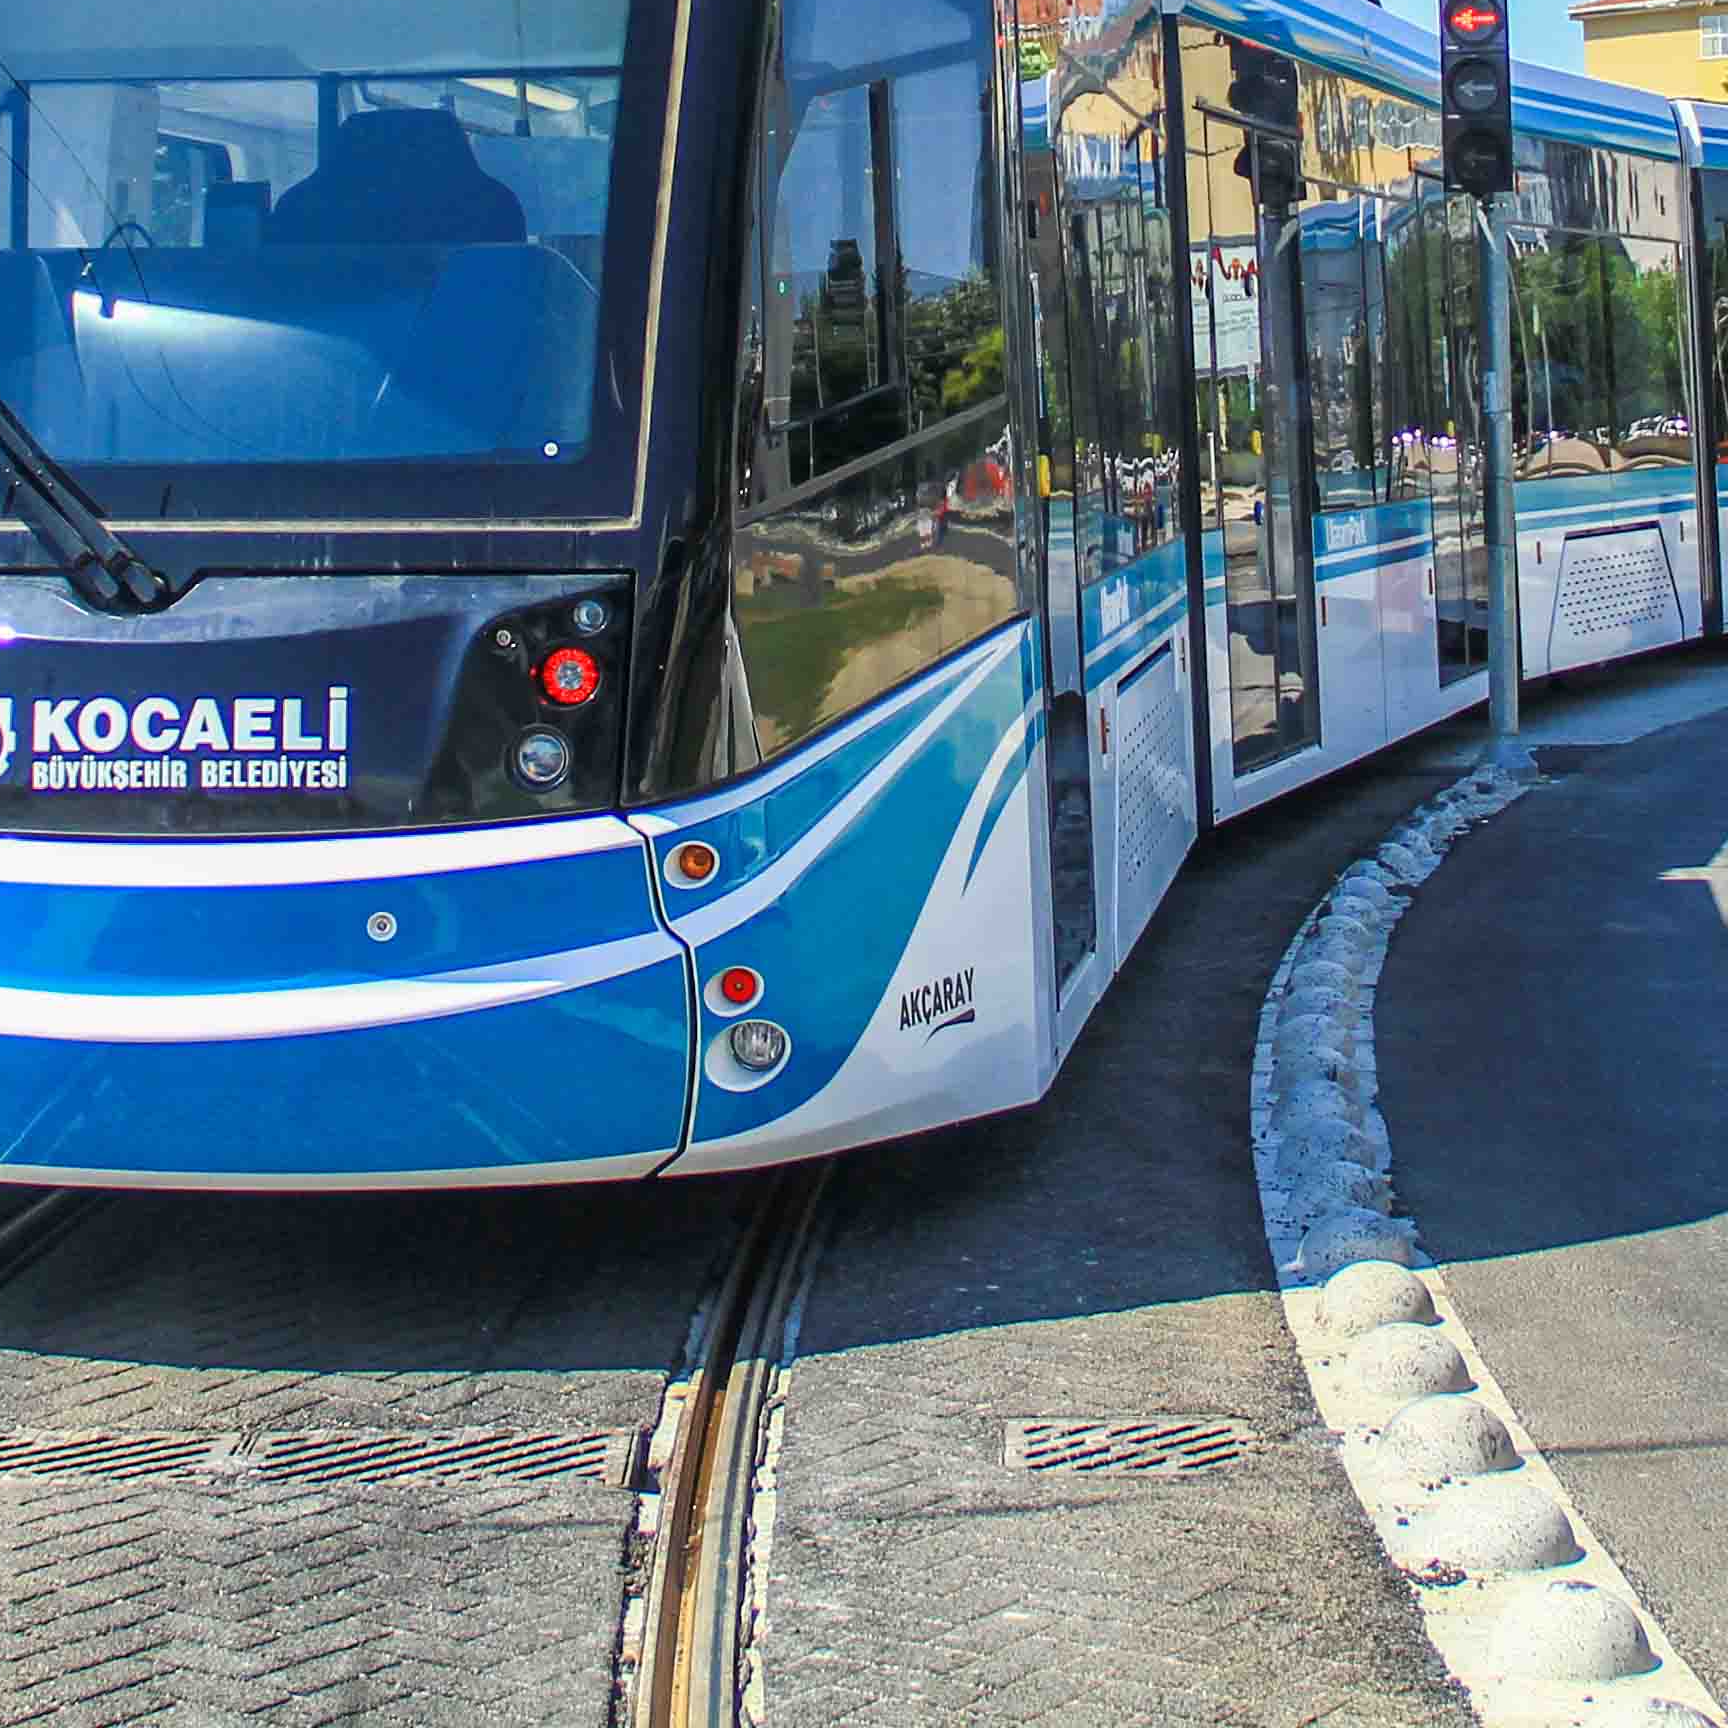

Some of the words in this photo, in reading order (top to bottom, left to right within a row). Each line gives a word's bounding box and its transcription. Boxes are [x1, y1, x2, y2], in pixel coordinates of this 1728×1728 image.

[32, 686, 349, 753] KOCAELİ
[32, 755, 188, 790] BÜYÜKŞEHİR
[200, 755, 348, 789] BELEDİYESİ
[899, 966, 975, 1031] AKÇARAY
